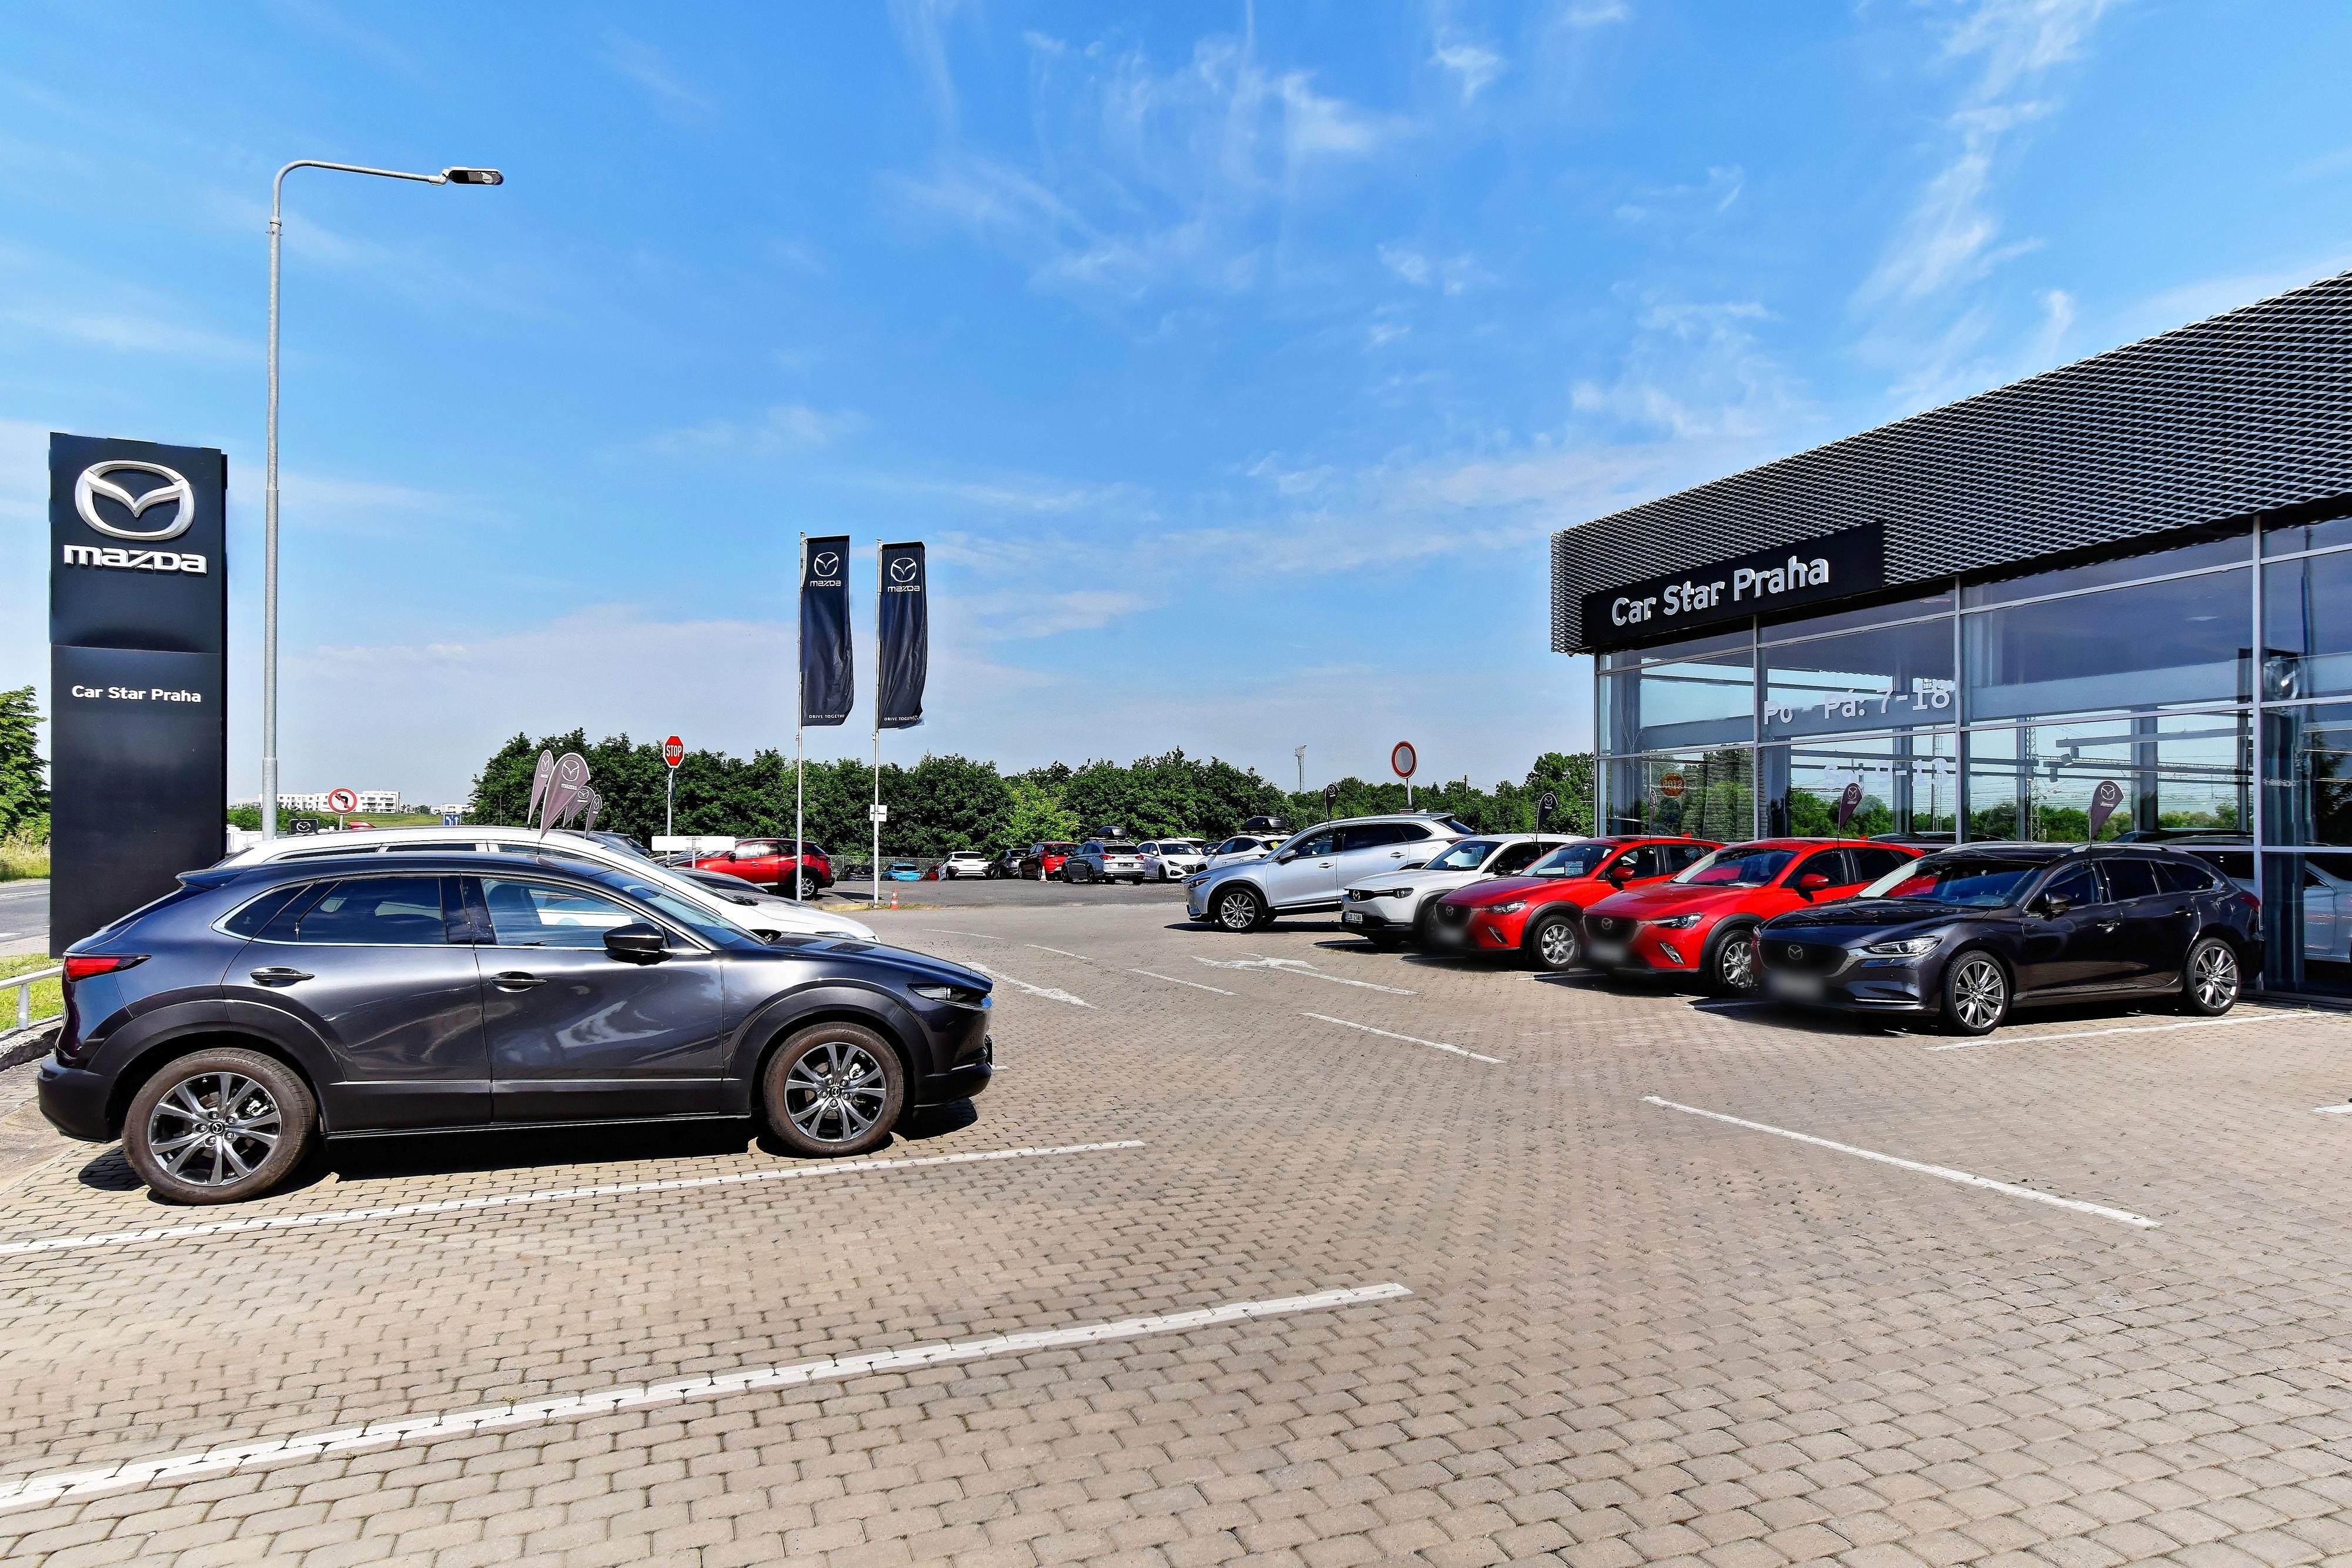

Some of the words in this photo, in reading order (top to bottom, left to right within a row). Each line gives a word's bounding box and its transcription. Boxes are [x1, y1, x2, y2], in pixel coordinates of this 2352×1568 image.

[1612, 597, 1656, 626] Car
[1663, 581, 1725, 616] Star
[1733, 555, 1829, 601] Praha
[72, 684, 103, 698] Car
[108, 686, 146, 700] Star
[151, 688, 202, 703] Praha
[1763, 700, 1793, 725] Po
[1824, 688, 1866, 719] Pá:
[666, 744, 682, 757] STOP
